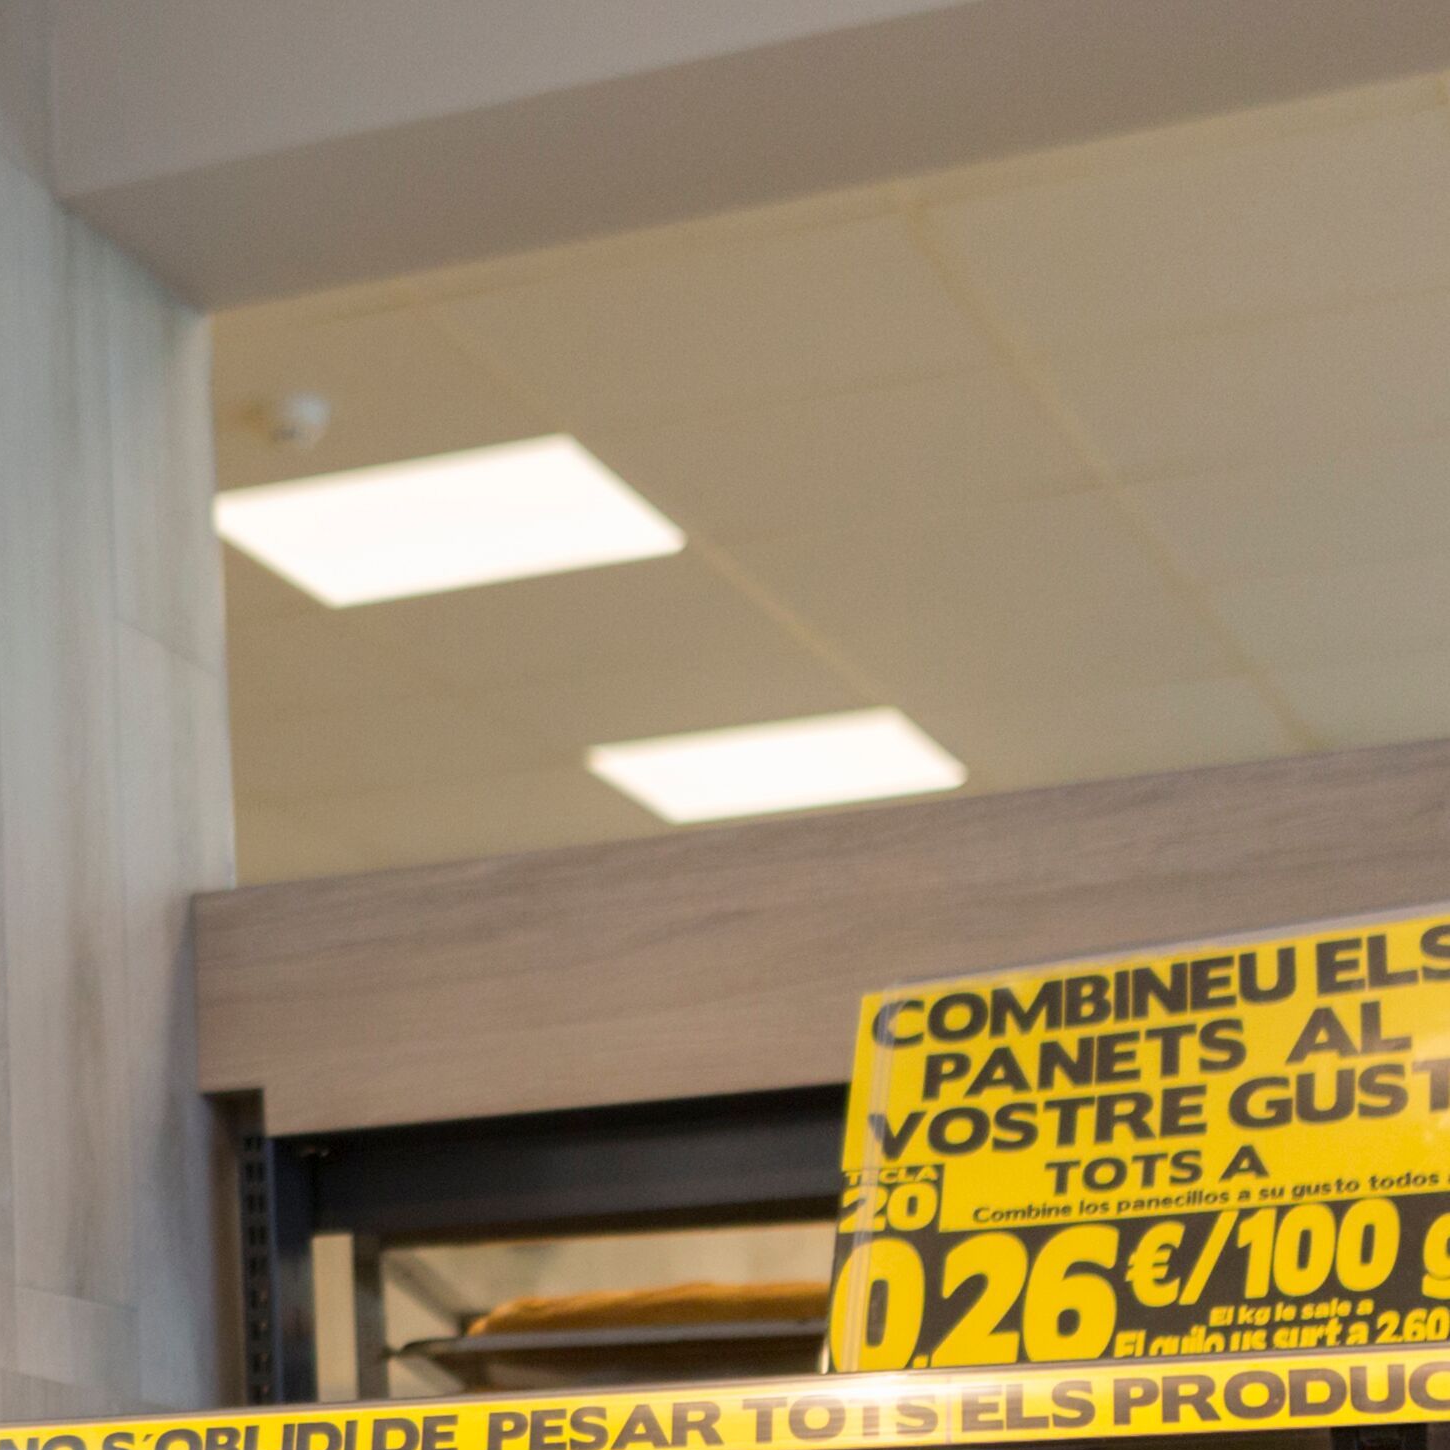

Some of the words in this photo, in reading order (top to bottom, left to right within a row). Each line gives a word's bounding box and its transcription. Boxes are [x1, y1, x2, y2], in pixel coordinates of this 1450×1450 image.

[872, 945, 1296, 1048] COMBINEU
[1316, 924, 1450, 997] ELS
[922, 1018, 1247, 1101] PANETS
[1285, 1001, 1412, 1065] AL
[867, 1085, 1207, 1161] VOSTRE
[843, 1165, 938, 1185] TCLA
[1045, 1150, 1203, 1195] TOTS
[1221, 1144, 1269, 1180] A
[839, 1183, 938, 1233] 20
[972, 1200, 1072, 1223] Combine
[1079, 1198, 1110, 1217] los
[1117, 1189, 1230, 1217] panecillos
[1238, 1188, 1252, 1202] a
[1258, 1184, 1285, 1200] su
[1291, 1179, 1360, 1199] gusto
[1369, 1171, 1440, 1190] todos
[1209, 1306, 1234, 1327] El
[1237, 1303, 1271, 1326] kg
[1275, 1300, 1297, 1321] le
[1301, 1298, 1351, 1320] sale
[1356, 1298, 1374, 1316] a
[1273, 1319, 1343, 1349] surt
[1346, 1321, 1369, 1345] a
[742, 1394, 939, 1444] TOTS
[961, 1380, 1096, 1432] ELS
[1113, 1361, 1450, 1427] PRODUC
